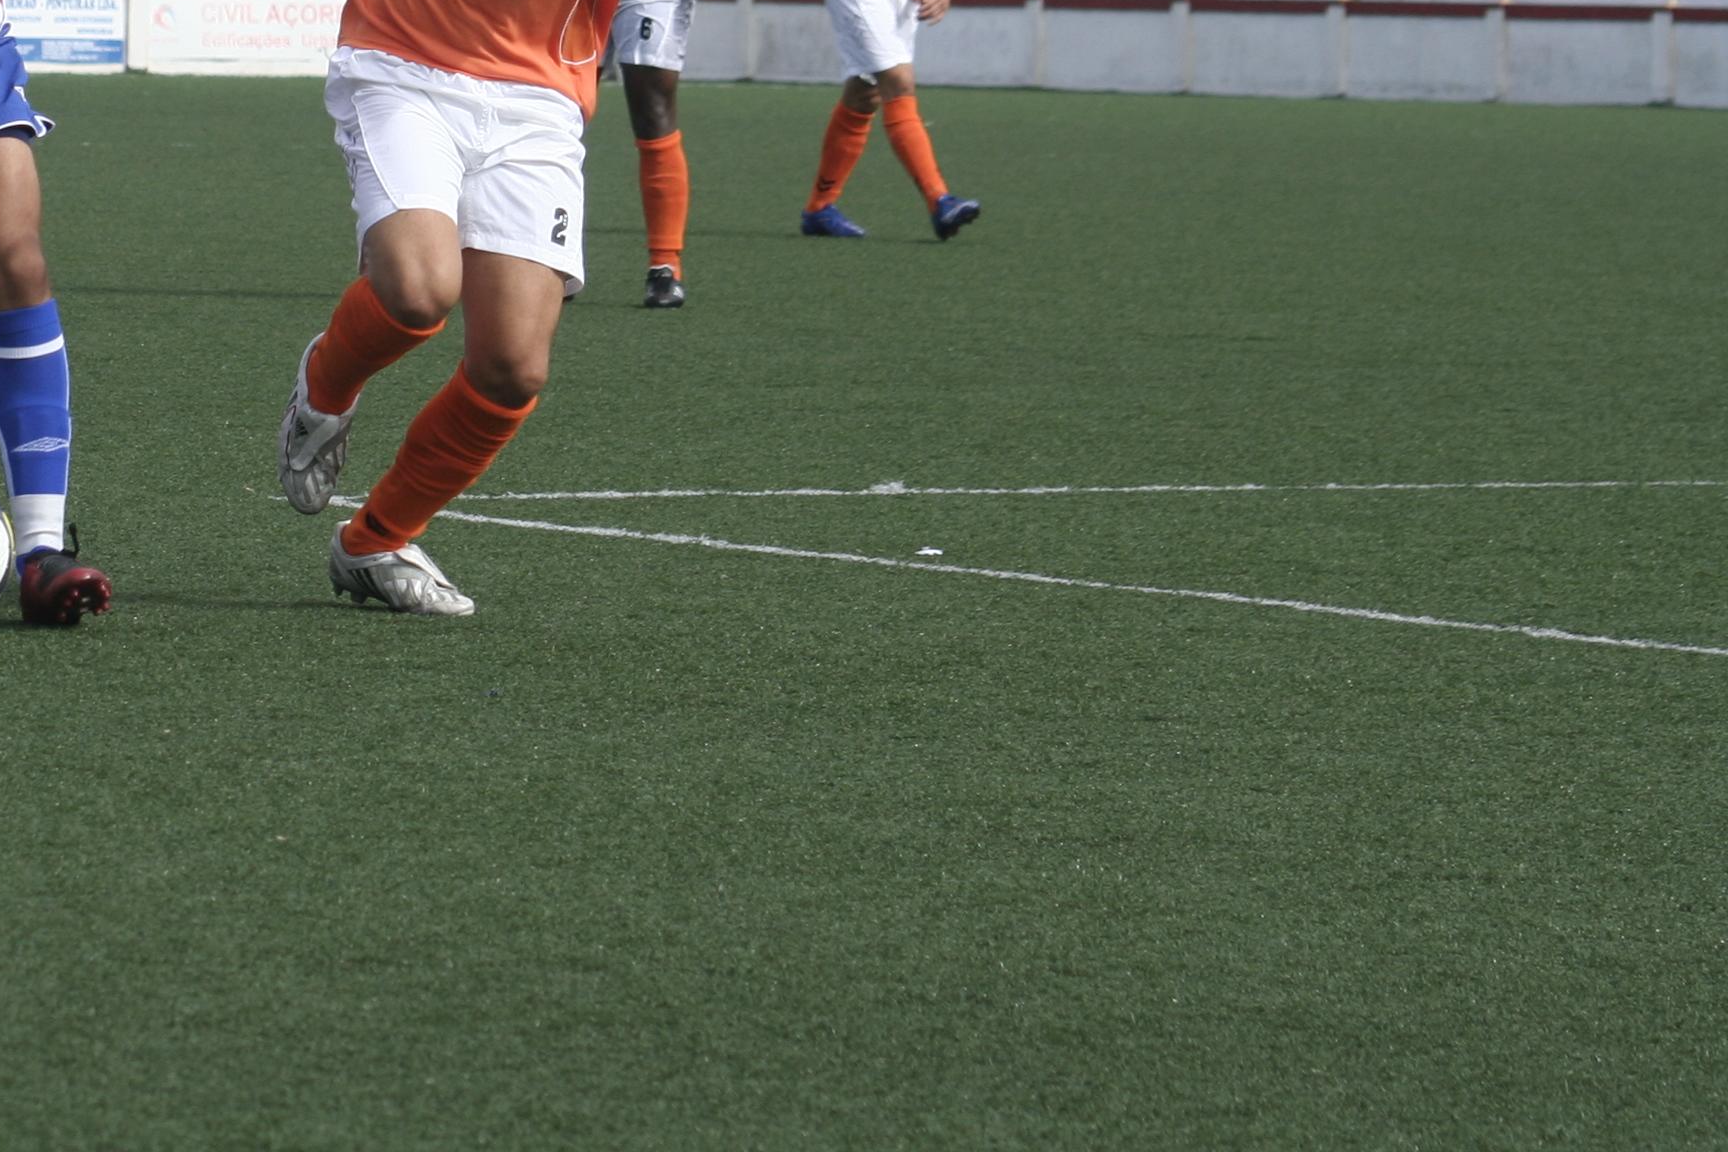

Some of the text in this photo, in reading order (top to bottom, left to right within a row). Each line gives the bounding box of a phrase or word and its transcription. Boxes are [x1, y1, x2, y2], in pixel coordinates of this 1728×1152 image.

[201, 4, 341, 27] CIVIL AÇOR
[640, 16, 653, 40] 6
[551, 207, 569, 247] 2
